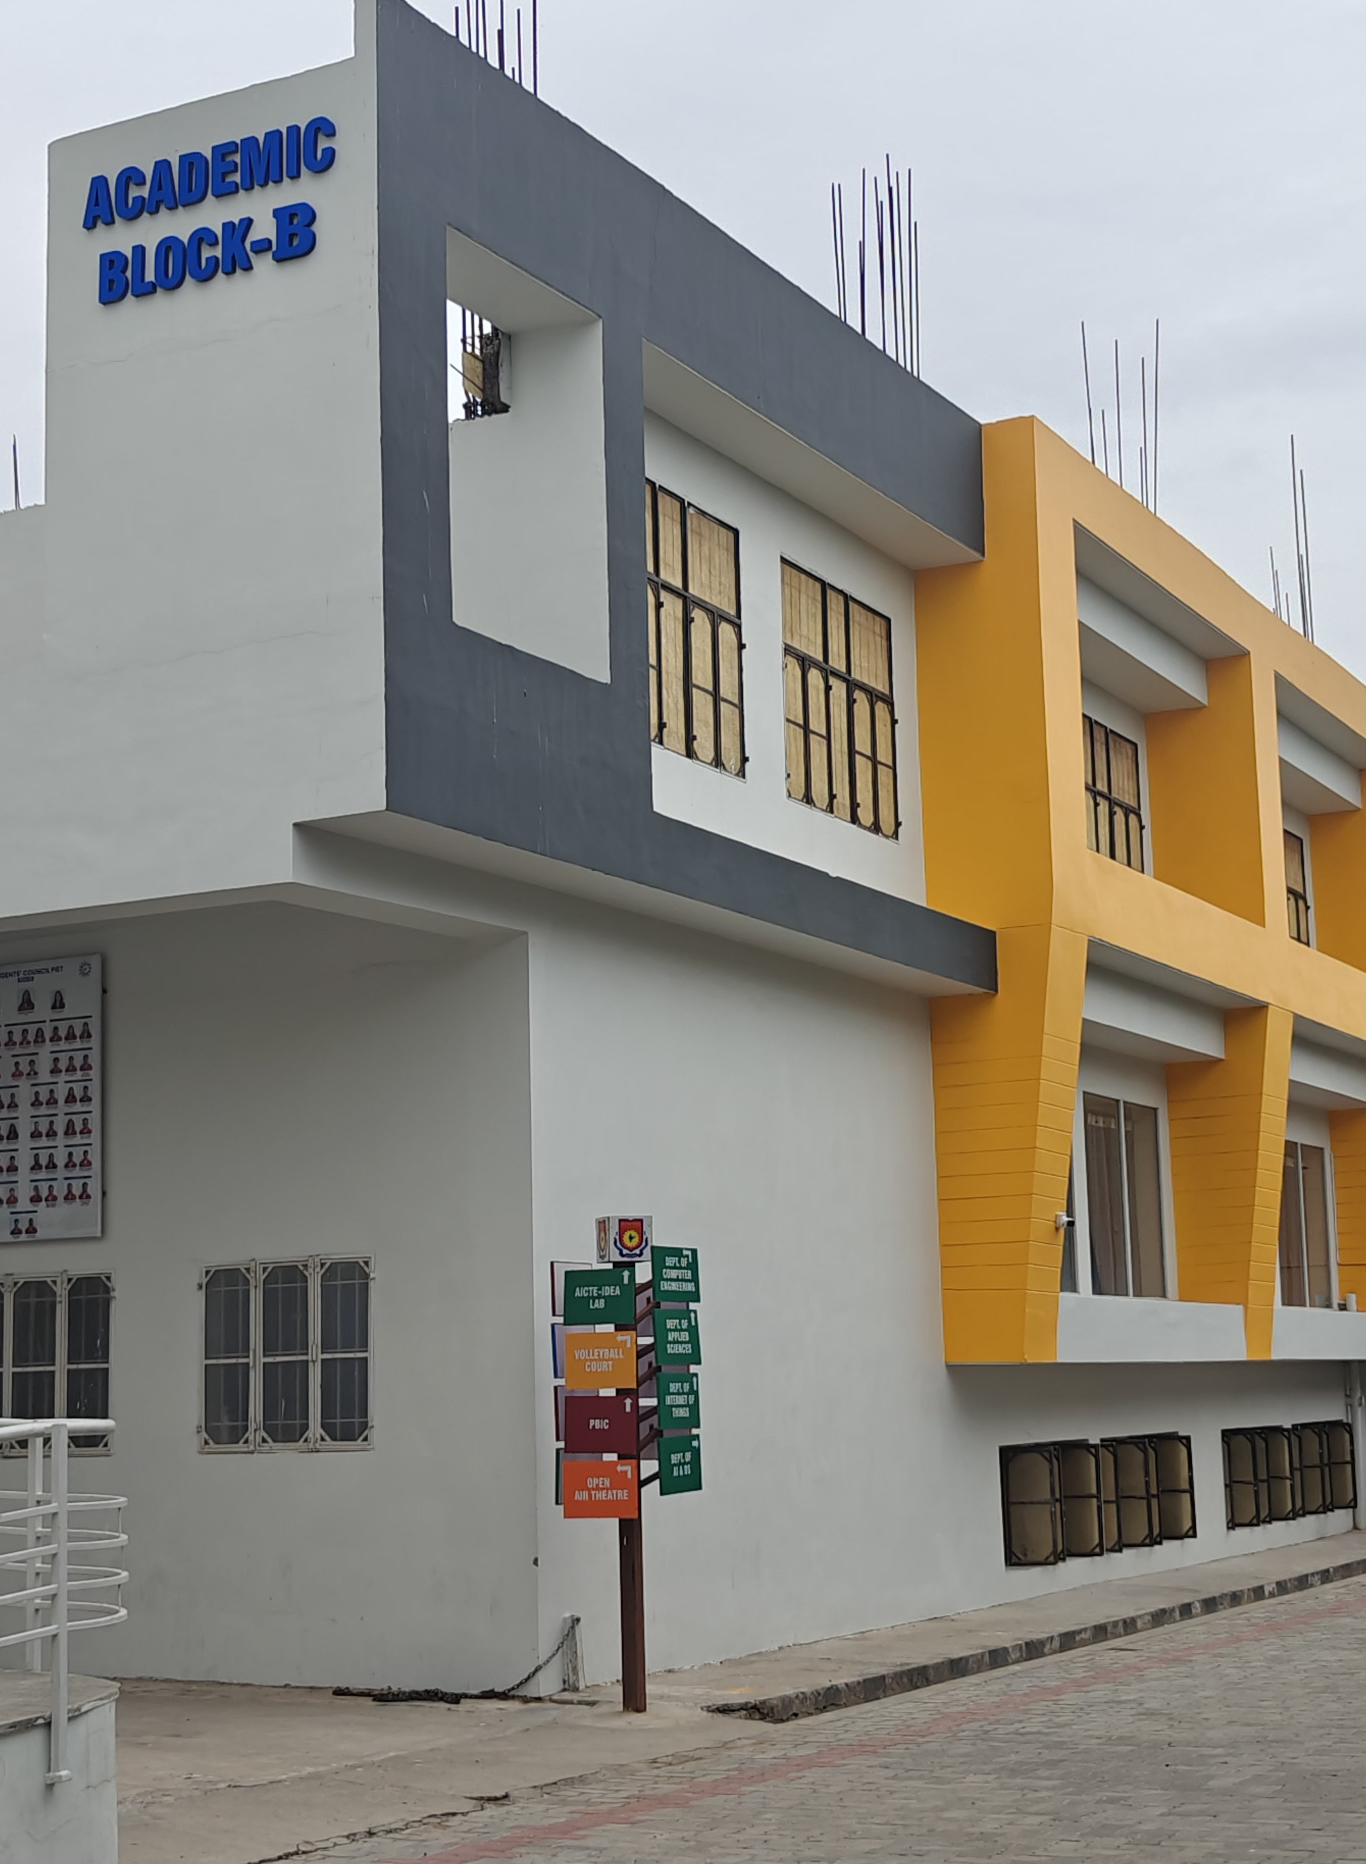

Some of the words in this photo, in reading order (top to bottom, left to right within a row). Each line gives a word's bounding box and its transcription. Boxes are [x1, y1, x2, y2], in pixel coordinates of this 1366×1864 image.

[82, 116, 337, 231] ACADEMIC
[98, 202, 317, 305] BLOCK-B
[665, 1256, 680, 1266] DEPT.
[680, 1257, 688, 1267] OF
[662, 1268, 692, 1280] COMPUTER
[574, 1285, 621, 1298] AICTE-IDEA
[660, 1280, 696, 1292] ENGINEERING
[589, 1298, 605, 1309] LAB
[666, 1319, 681, 1329] DEPT.
[681, 1319, 688, 1329] OF
[667, 1331, 689, 1341] APPLIED
[574, 1348, 624, 1360] VOLLEYBALL
[666, 1343, 692, 1354] SCIENCES
[585, 1360, 614, 1372] COURT
[669, 1382, 683, 1393] DEPT.
[683, 1382, 690, 1392] OF
[665, 1394, 688, 1405] INTERNET
[688, 1394, 695, 1405] OF
[671, 1407, 690, 1418] THINGS
[588, 1419, 609, 1430] PBIC
[670, 1452, 684, 1464] DEPT.
[684, 1451, 692, 1462] OF
[587, 1477, 610, 1488] OPEN
[574, 1490, 589, 1501] AIR
[591, 1489, 629, 1501] THEATRE
